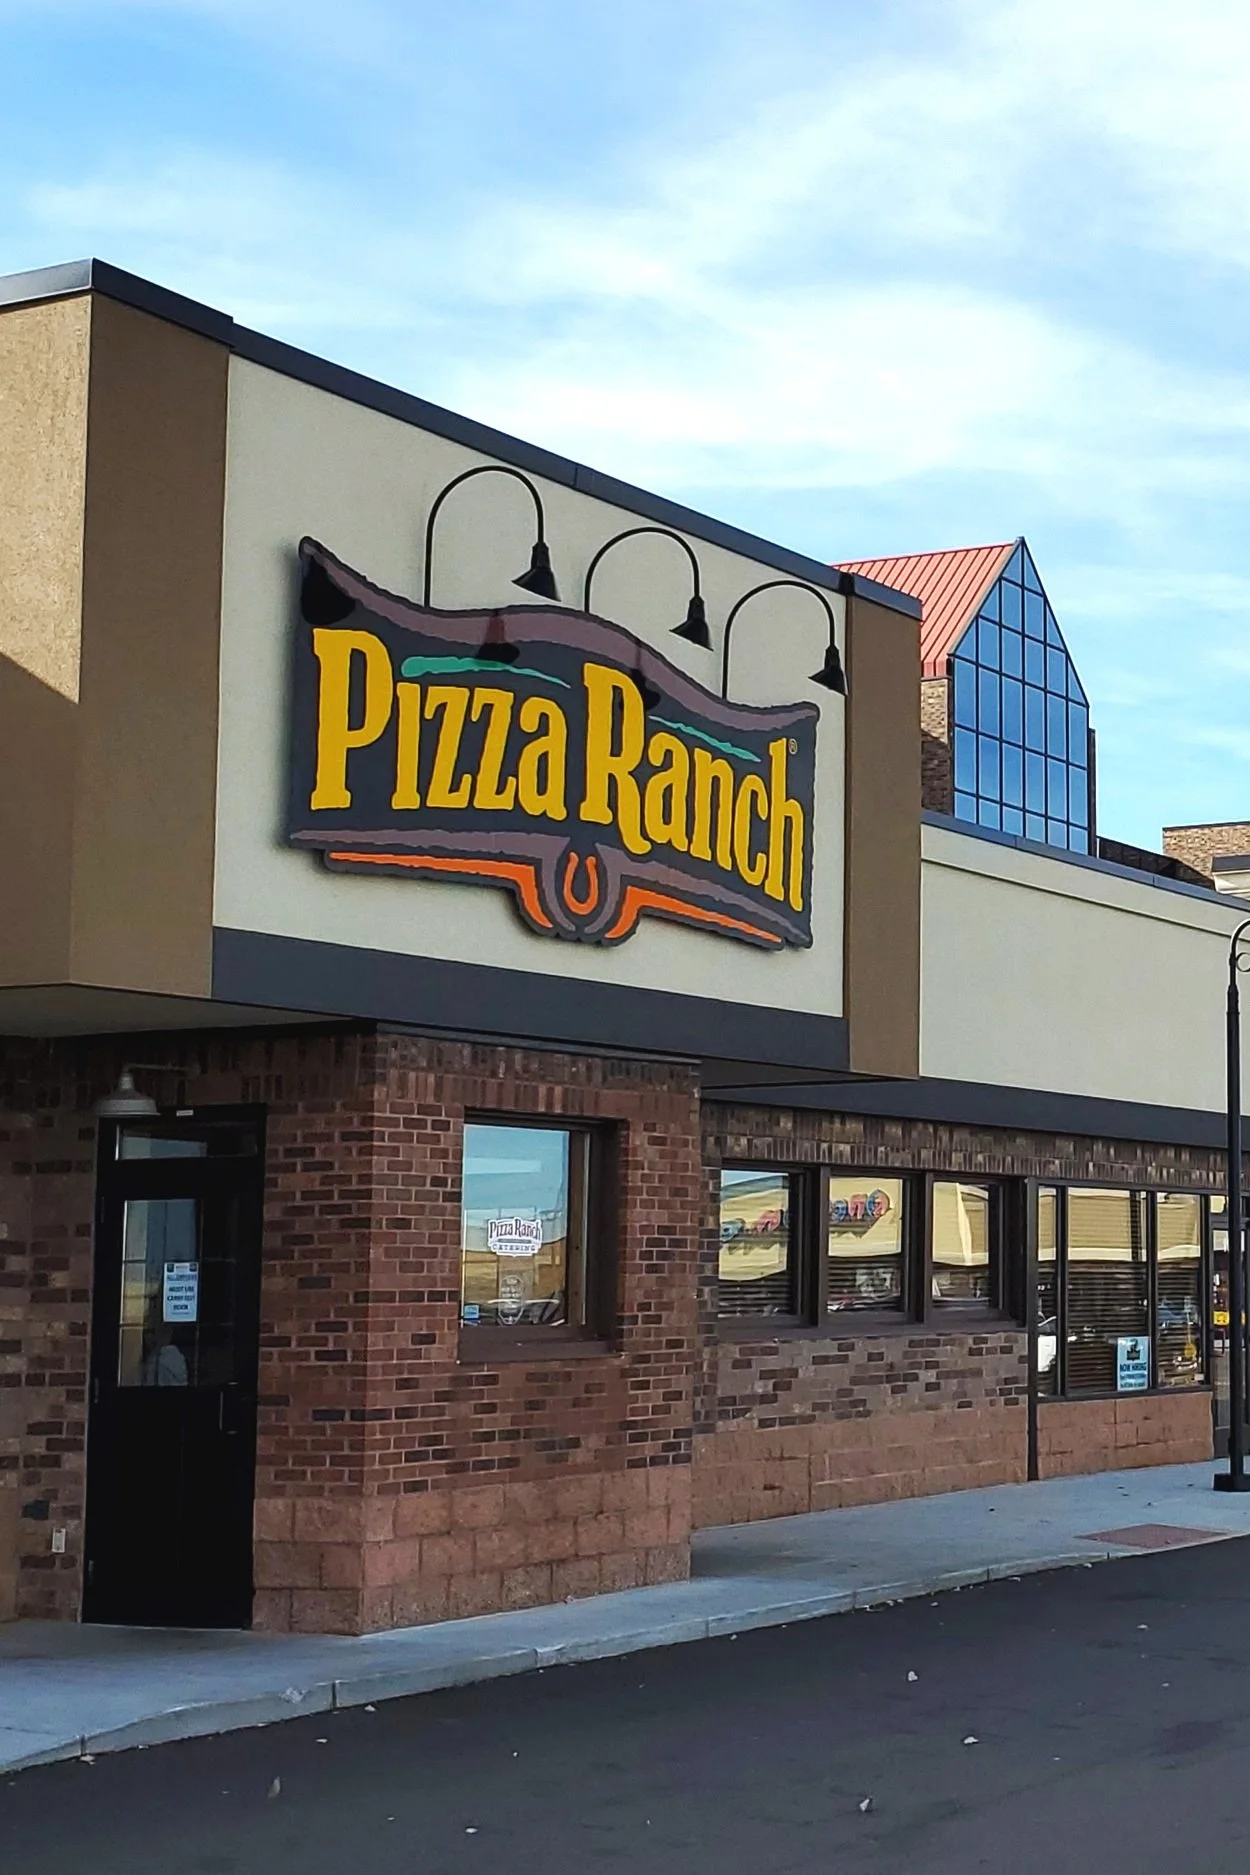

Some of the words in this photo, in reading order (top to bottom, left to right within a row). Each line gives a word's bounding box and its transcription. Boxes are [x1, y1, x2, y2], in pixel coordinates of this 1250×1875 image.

[311, 627, 568, 822] Pizza
[580, 662, 804, 912] Ranch
[489, 1220, 514, 1239] Pizza
[514, 1218, 541, 1241] Ranch
[492, 1243, 536, 1251] CATERING
